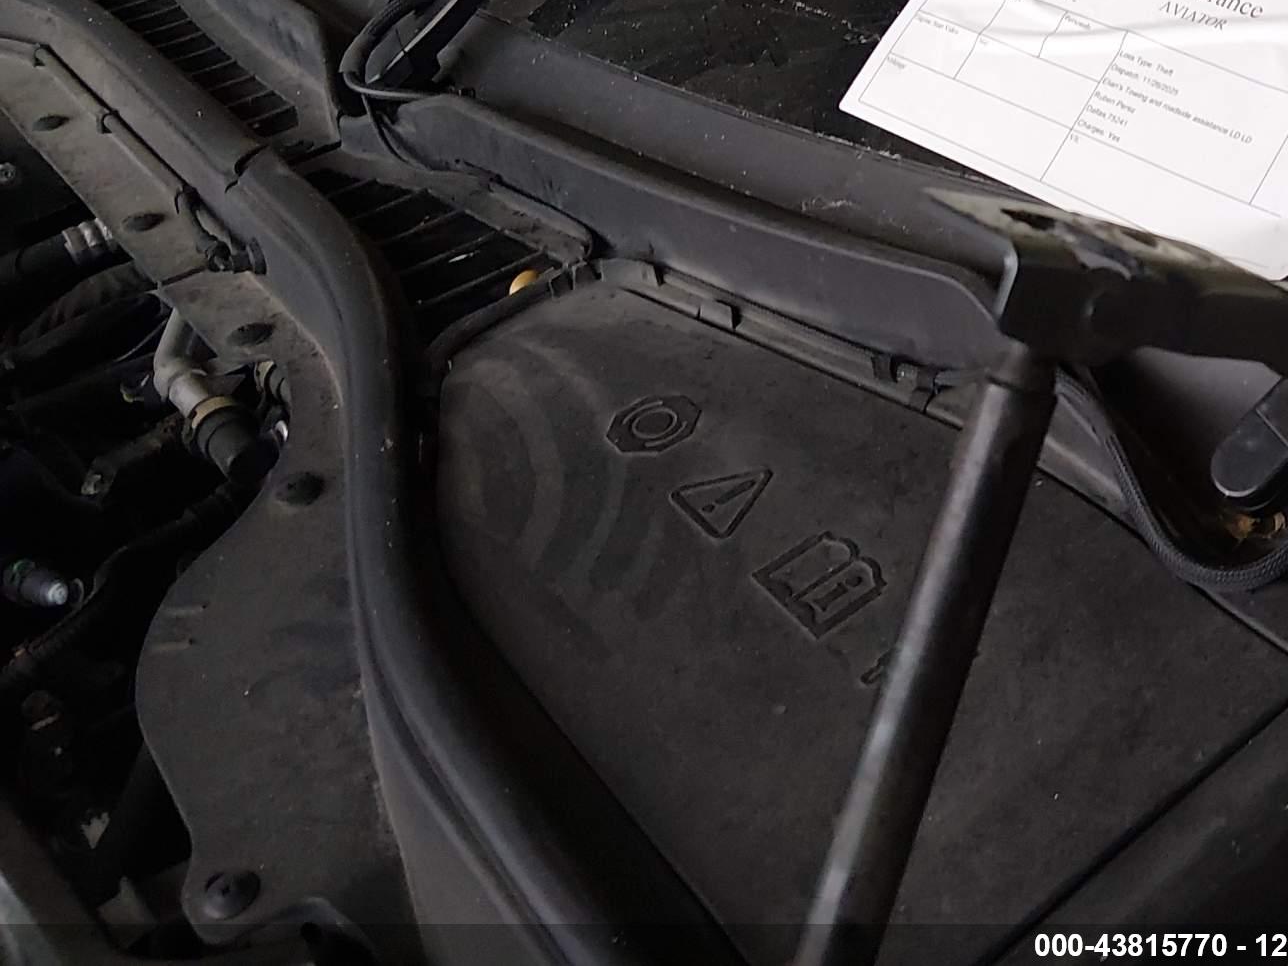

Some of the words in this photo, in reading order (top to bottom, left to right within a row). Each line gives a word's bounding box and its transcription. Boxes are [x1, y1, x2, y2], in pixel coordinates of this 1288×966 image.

[1158, 0, 1230, 31] AVIATOR
[1156, 62, 1174, 77] Theft
[1149, 94, 1164, 107] and
